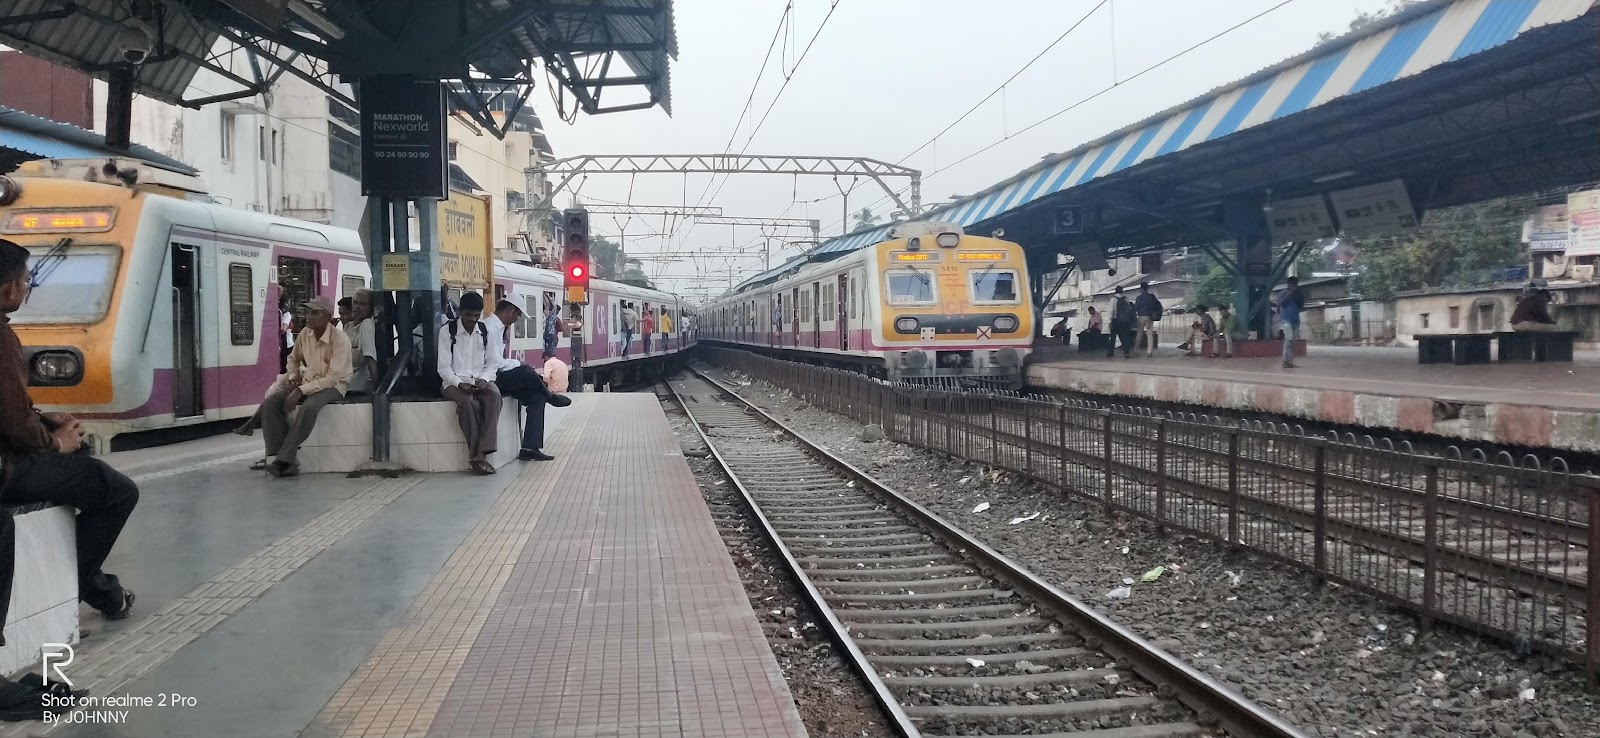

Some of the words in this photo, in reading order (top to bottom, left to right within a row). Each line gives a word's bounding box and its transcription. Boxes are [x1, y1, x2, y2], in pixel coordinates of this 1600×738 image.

[373, 121, 429, 132] Nexworld
[419, 151, 430, 159] 90
[1062, 210, 1074, 227] 3
[221, 247, 240, 256] CENTRAL
[240, 249, 259, 258] RAILWAY
